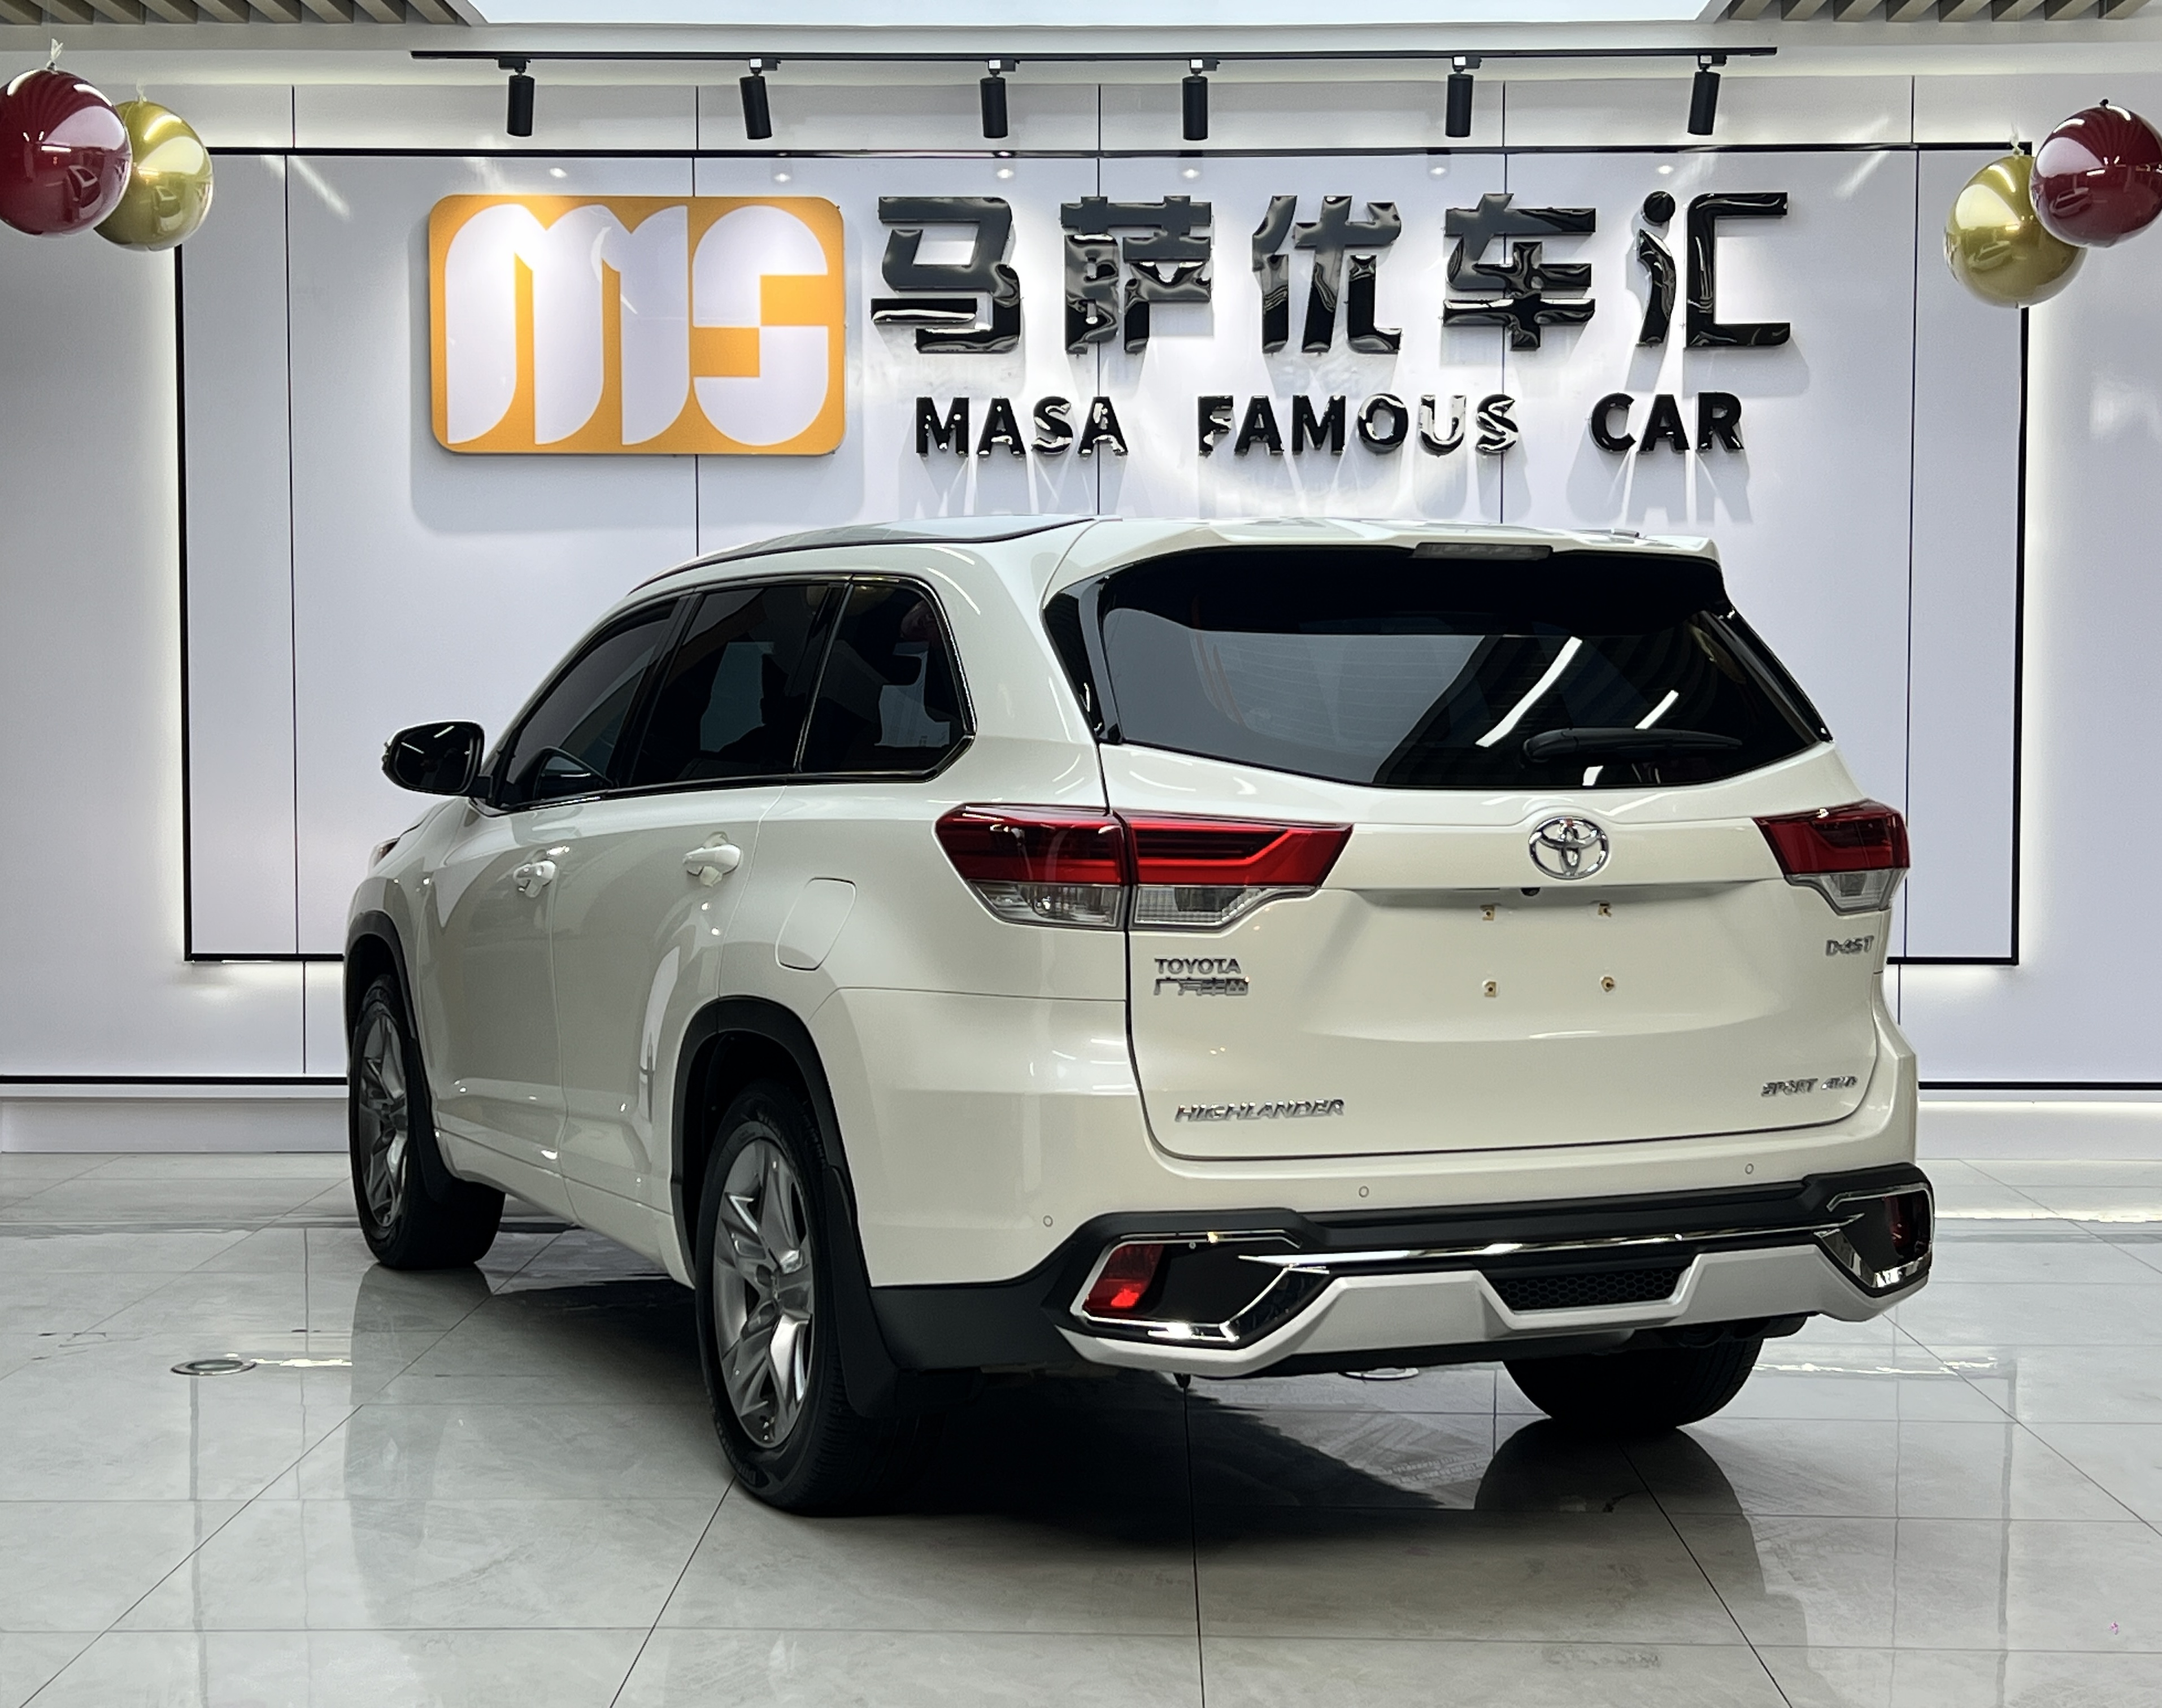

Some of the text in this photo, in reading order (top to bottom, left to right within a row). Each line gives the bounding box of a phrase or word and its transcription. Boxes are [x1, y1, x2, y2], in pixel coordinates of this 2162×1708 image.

[871, 190, 1790, 354] 马萨优车汇
[915, 391, 1745, 458] MASA FAMOUS CAR
[1154, 958, 1241, 974] TOYOTA
[1174, 1099, 1345, 1122] HIGHLANDER
